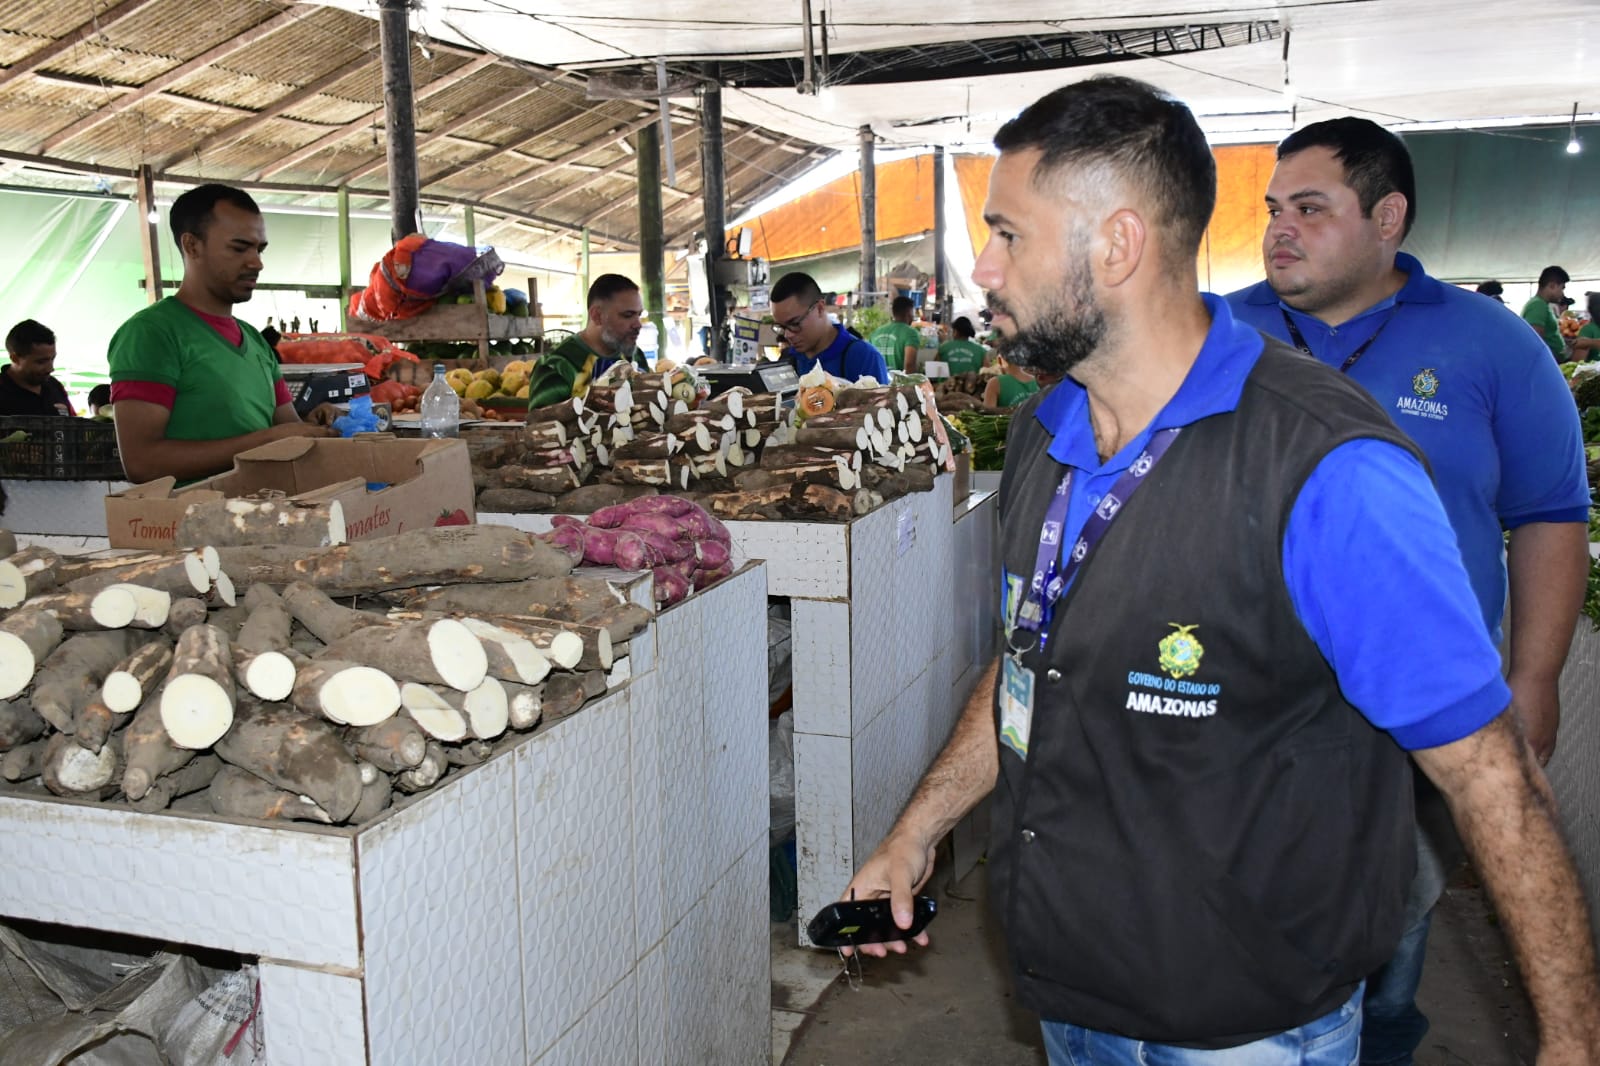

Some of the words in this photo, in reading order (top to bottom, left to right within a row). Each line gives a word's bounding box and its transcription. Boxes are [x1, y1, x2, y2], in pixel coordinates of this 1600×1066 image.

[1396, 396, 1448, 416] AMAZONAS
[1128, 671, 1163, 690] GOVERNO
[1164, 680, 1176, 692] DO
[1177, 681, 1207, 695] ESTADO
[1207, 683, 1221, 695] DO
[1126, 691, 1218, 718] AMAZONAS
